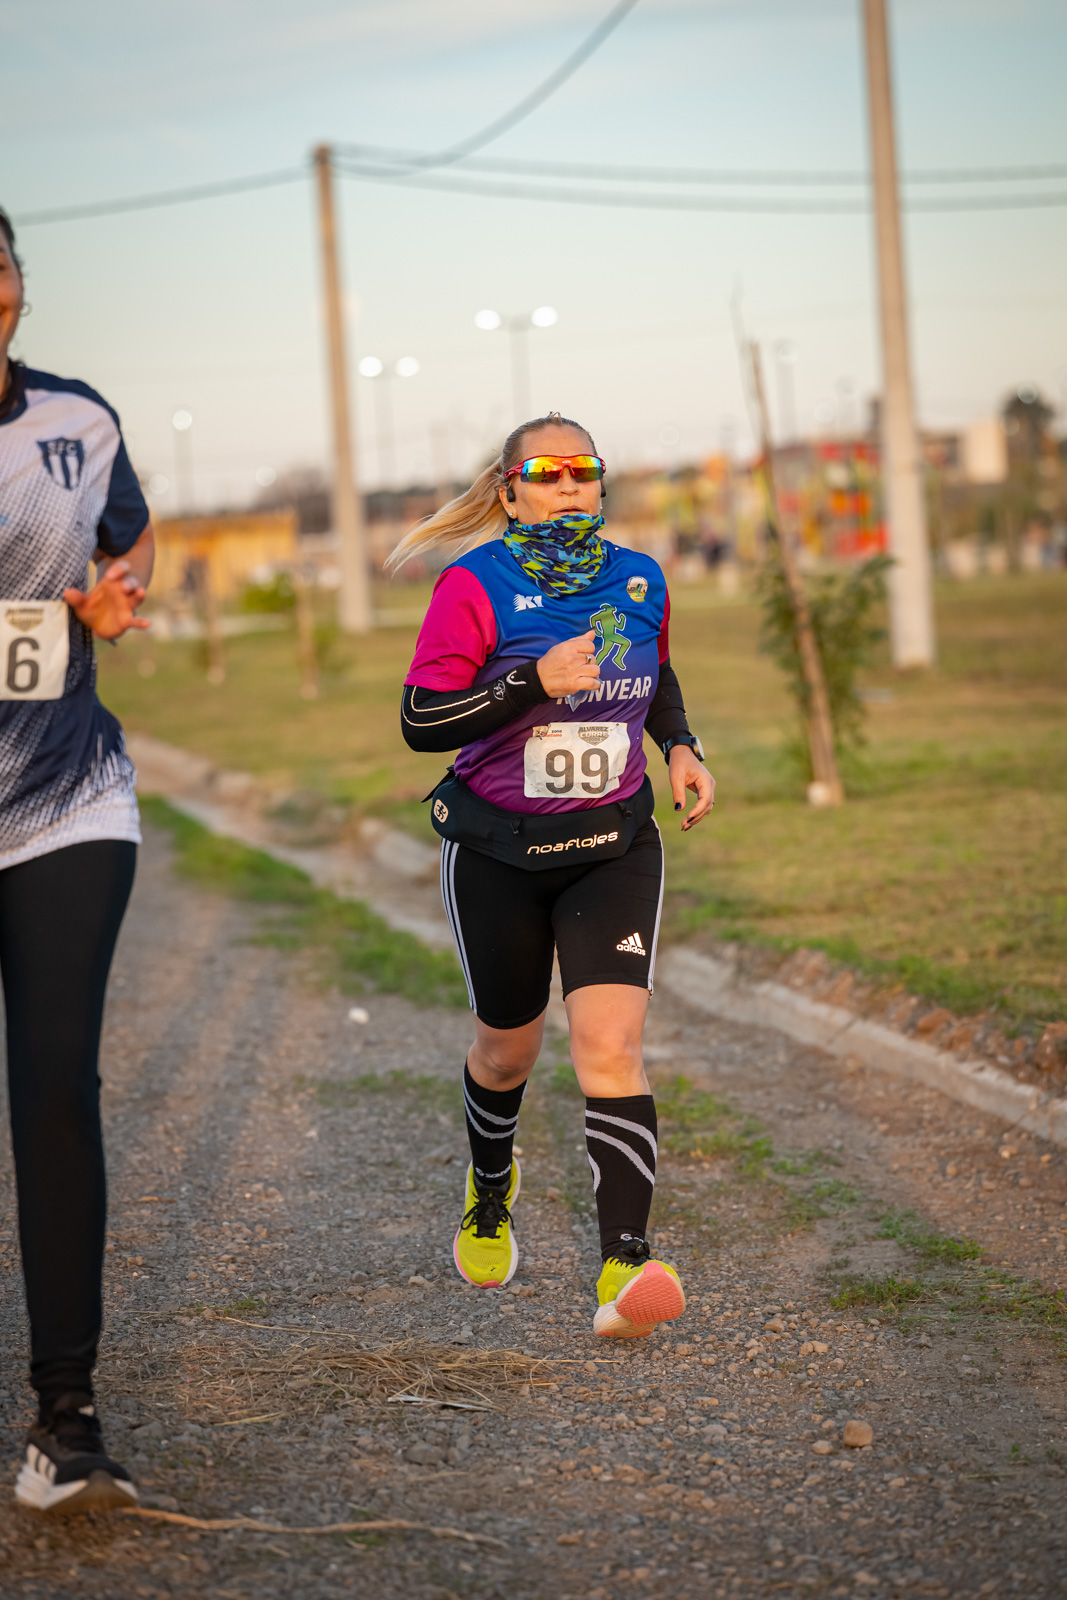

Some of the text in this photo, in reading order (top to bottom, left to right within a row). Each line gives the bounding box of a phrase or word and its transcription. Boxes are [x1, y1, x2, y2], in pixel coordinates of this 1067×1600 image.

[6, 637, 40, 693] 6
[545, 748, 609, 794] 99
[526, 831, 619, 855] noaflojes
[616, 944, 646, 956] adidas
